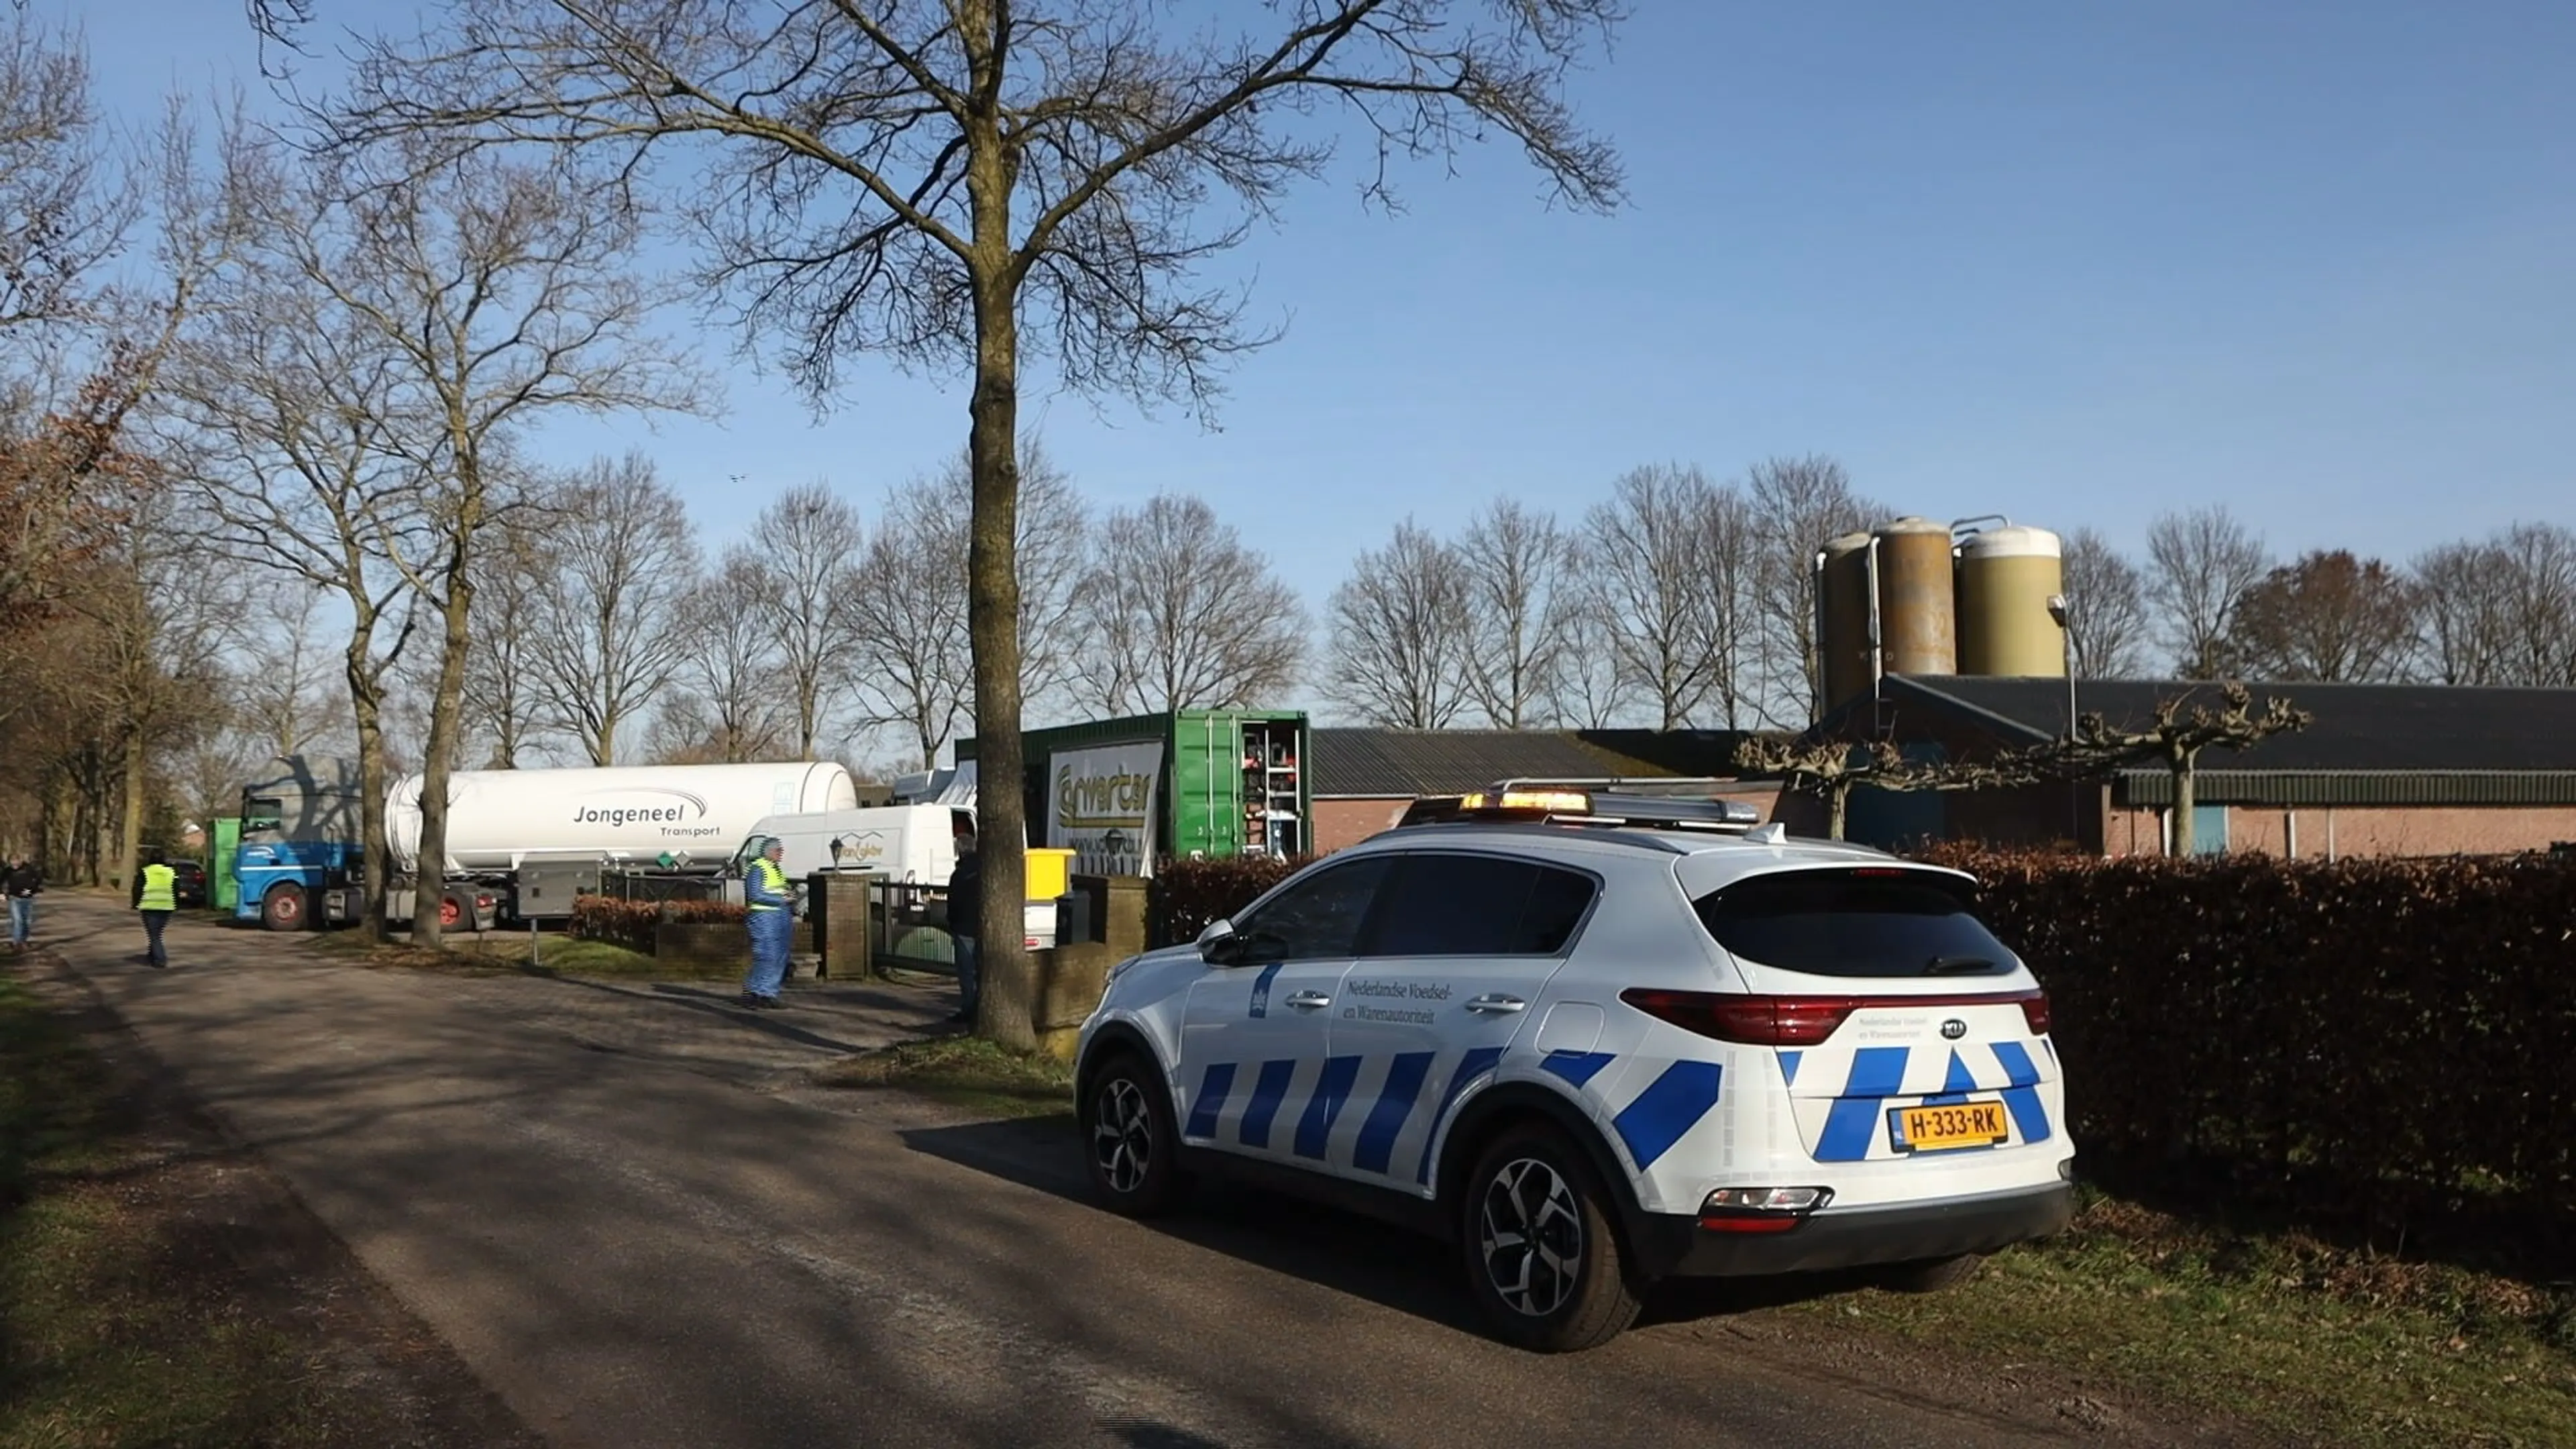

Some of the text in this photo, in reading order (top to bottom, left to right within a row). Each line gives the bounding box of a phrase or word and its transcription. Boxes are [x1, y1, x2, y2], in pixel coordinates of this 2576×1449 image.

[574, 804, 684, 827] Jongeneel
[660, 826, 720, 838] Transport
[1348, 981, 1407, 998] Nederlandse
[1343, 1004, 1436, 1024] en Warenautoriteit
[1911, 1108, 1998, 1138] H-333-RK
